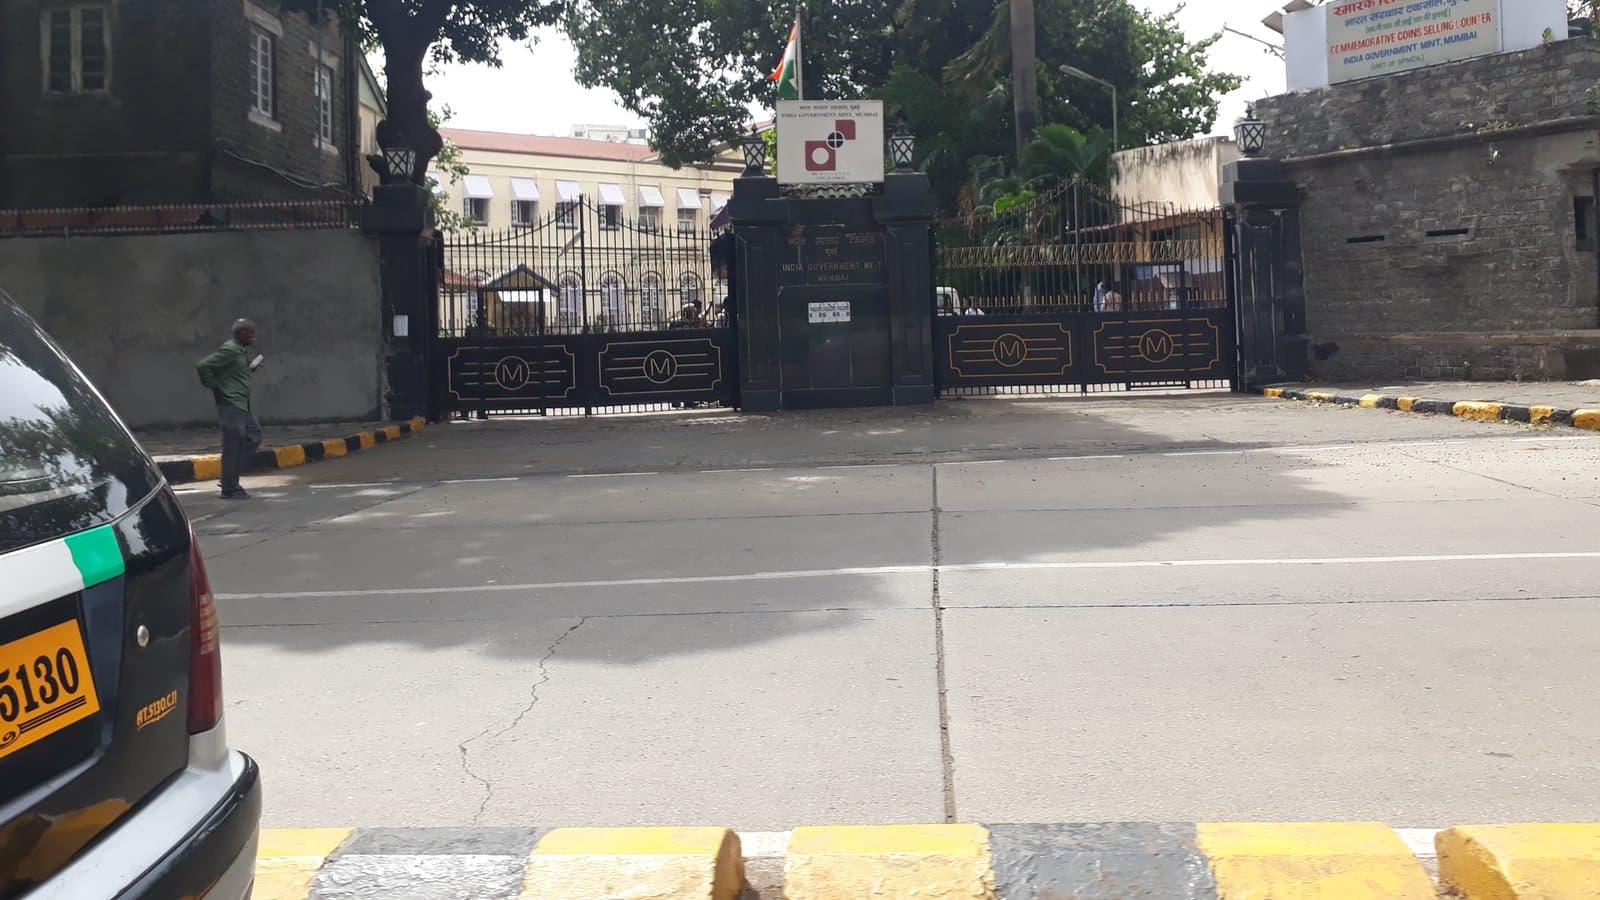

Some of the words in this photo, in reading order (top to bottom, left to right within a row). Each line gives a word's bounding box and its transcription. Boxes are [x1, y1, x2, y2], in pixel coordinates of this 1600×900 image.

[1397, 26, 1422, 41] COINS
[1423, 21, 1454, 36] SELLING
[1343, 55, 1364, 65] INDIA
[1364, 43, 1418, 61] GOVERNMENT
[1443, 31, 1477, 45] MUMBAI
[782, 263, 802, 272] INDIA
[807, 261, 860, 272] GOVERNMENT
[1000, 340, 1020, 359] M
[1146, 336, 1167, 354] M
[502, 364, 523, 383] M
[650, 358, 670, 376] M
[0, 647, 79, 722] 5130
